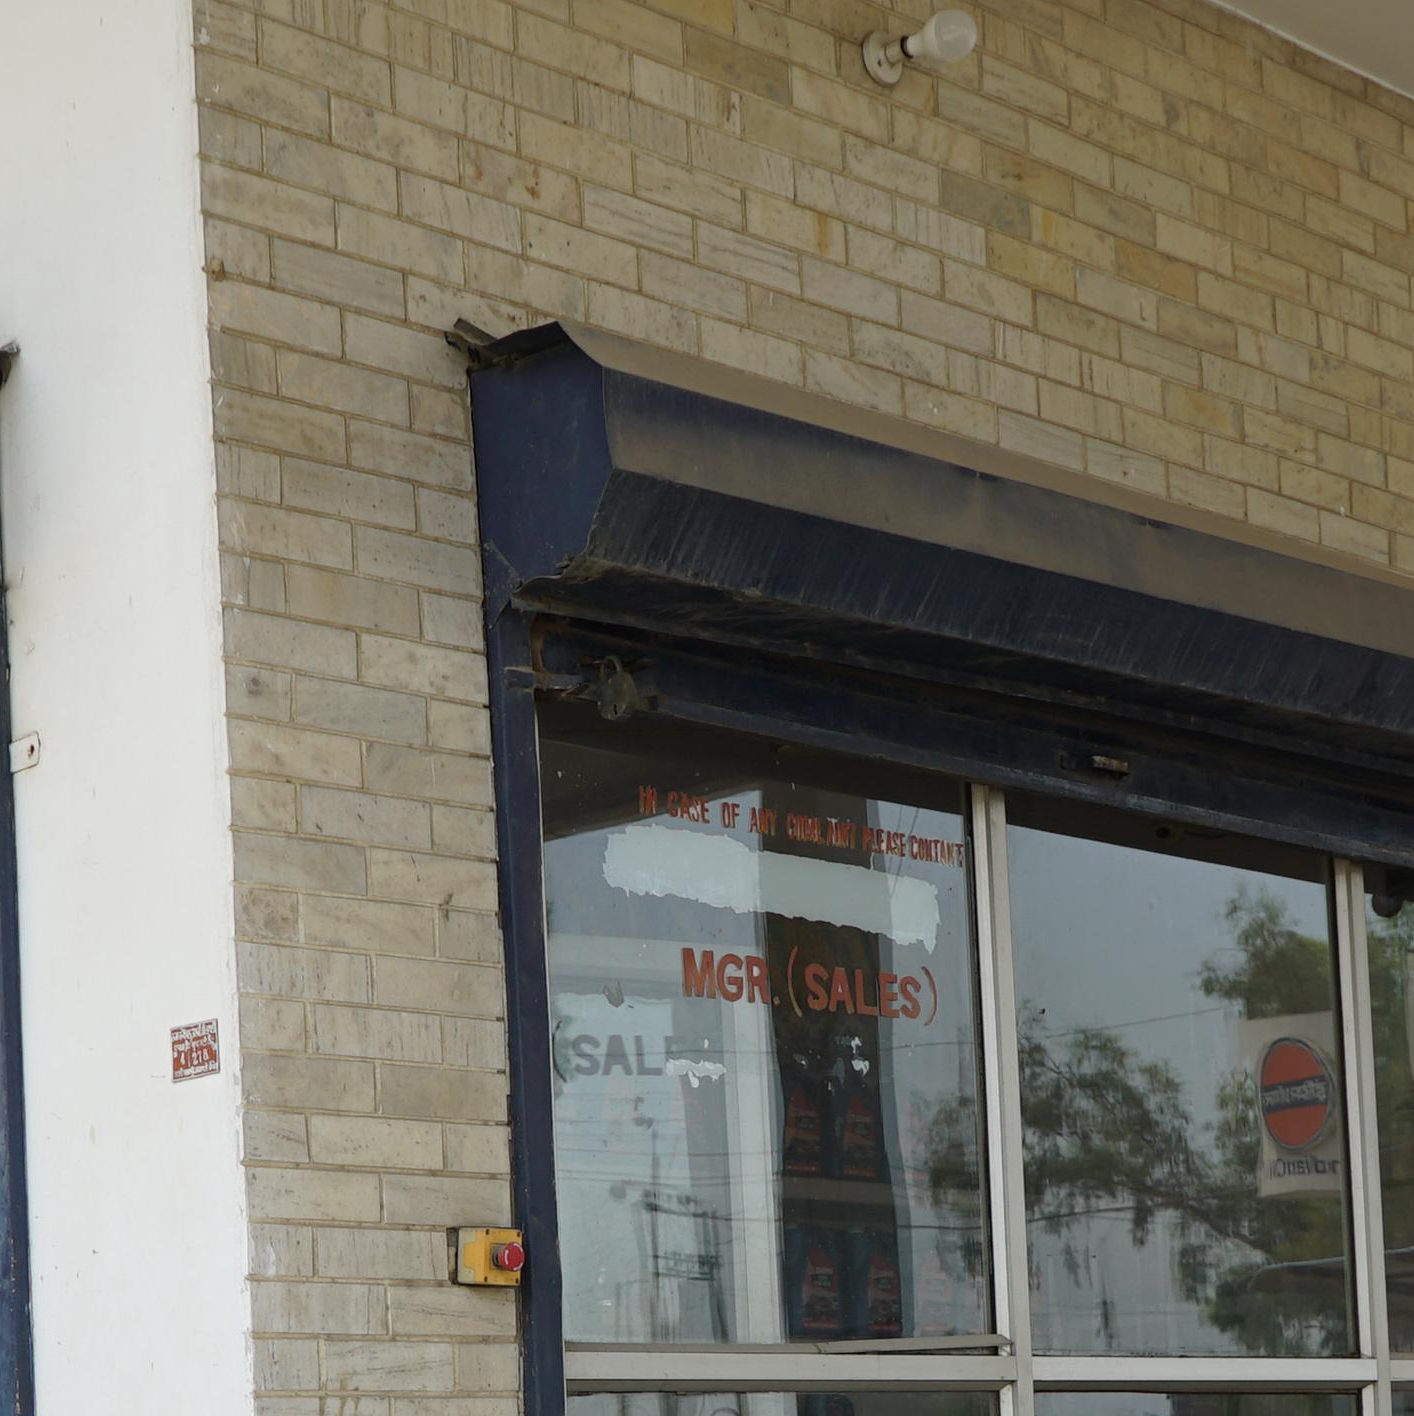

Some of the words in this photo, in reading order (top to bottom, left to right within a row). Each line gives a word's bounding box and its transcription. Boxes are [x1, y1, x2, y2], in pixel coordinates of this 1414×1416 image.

[638, 785, 658, 815] IN
[667, 791, 710, 825] CASE
[721, 802, 740, 829] OF
[748, 807, 777, 836] ANY
[862, 826, 906, 858] PLEASE
[788, 946, 938, 1027] (SALES)
